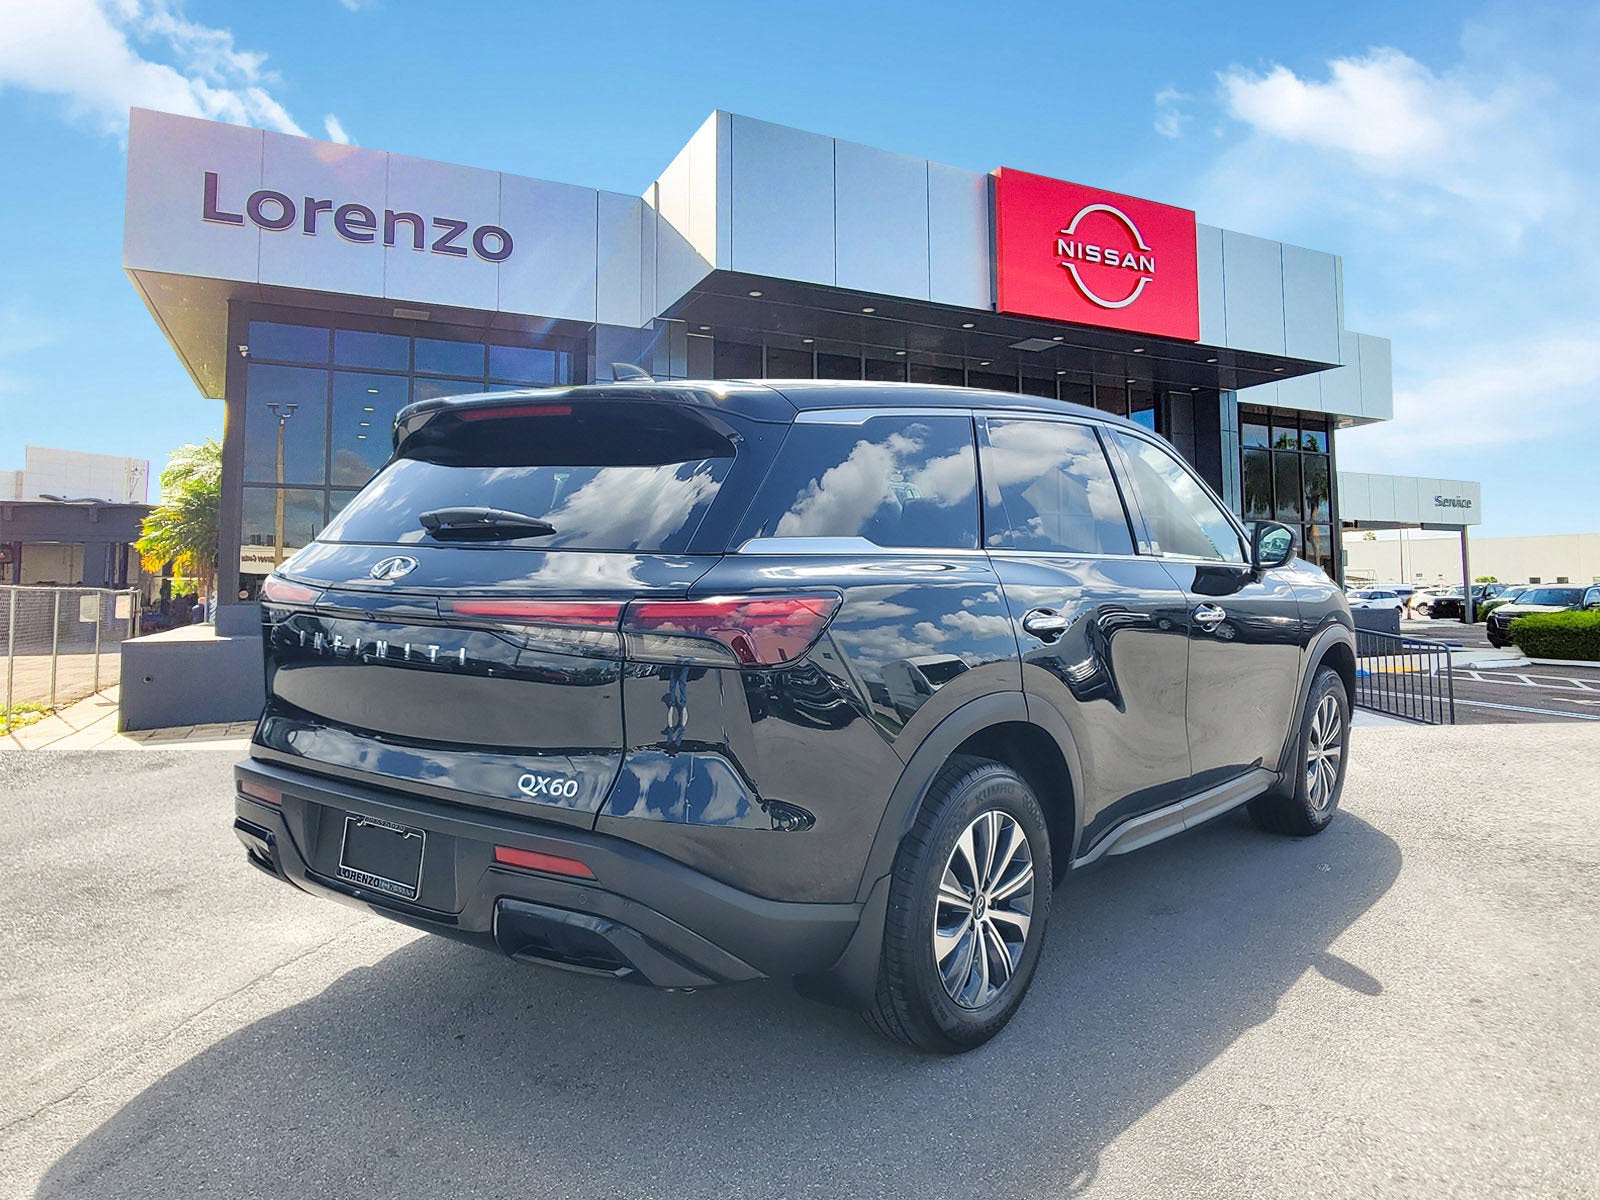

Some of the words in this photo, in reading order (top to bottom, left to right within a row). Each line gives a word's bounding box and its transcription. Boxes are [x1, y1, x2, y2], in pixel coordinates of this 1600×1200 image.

[202, 171, 514, 262] Lorenzo
[1057, 239, 1156, 273] NISSAN
[1434, 495, 1472, 508] Service
[299, 630, 466, 666] INFINITI
[517, 773, 579, 798] QX60
[337, 868, 380, 887] LORENZO
